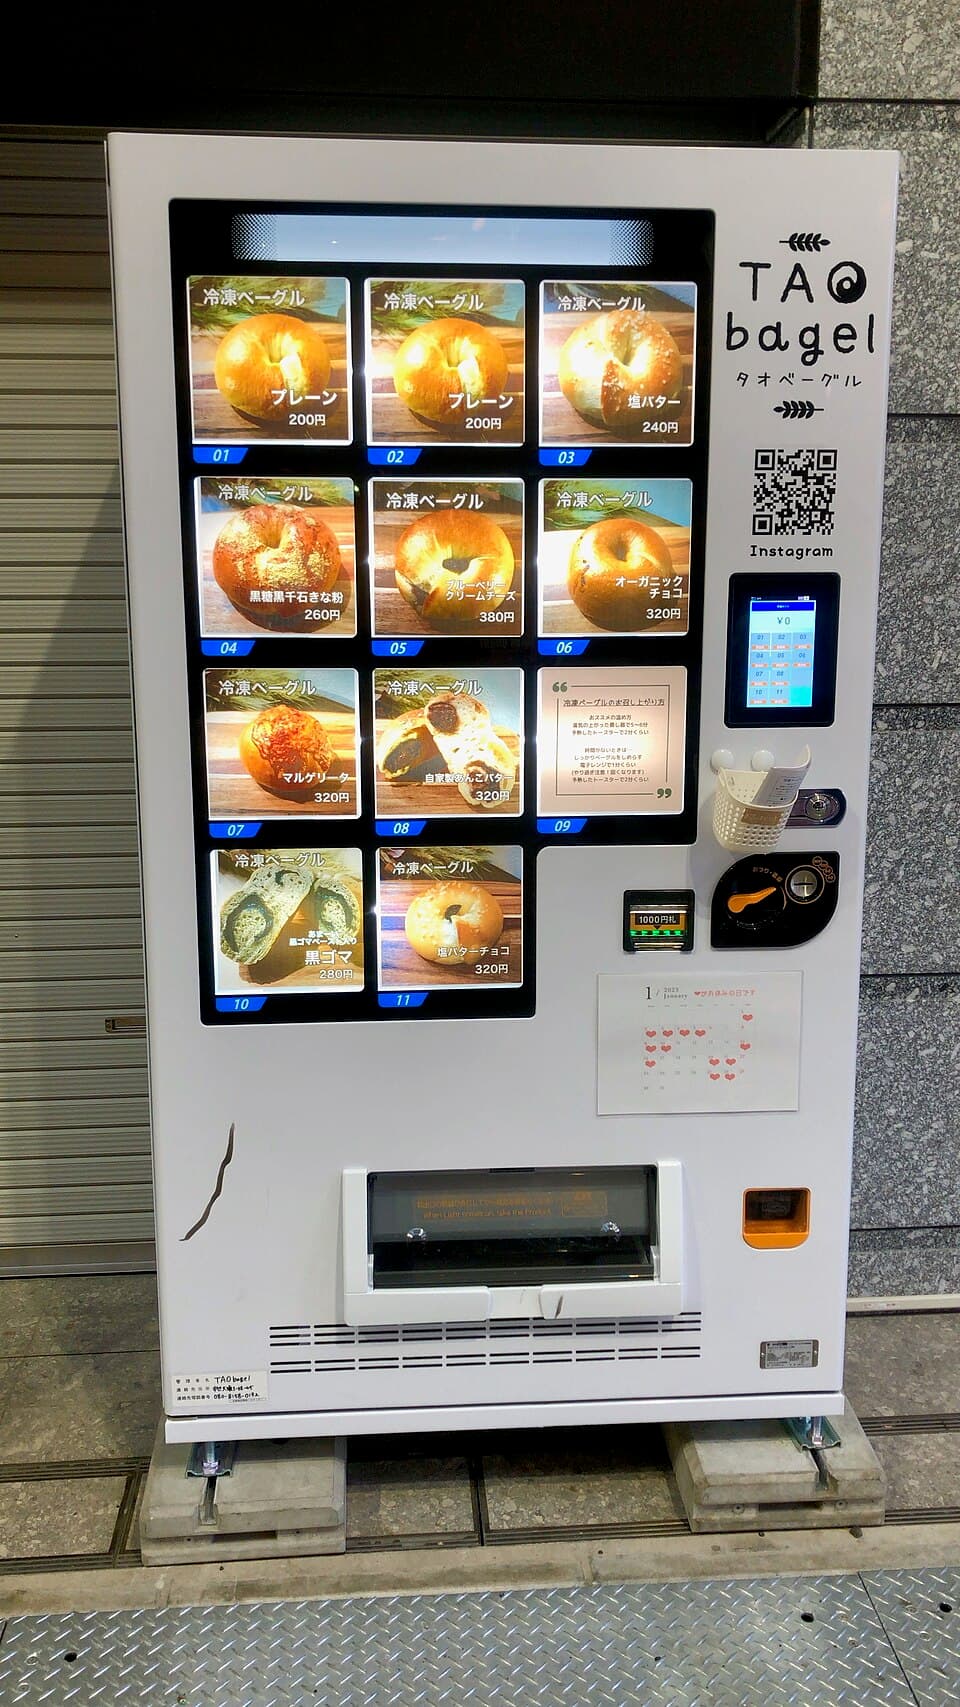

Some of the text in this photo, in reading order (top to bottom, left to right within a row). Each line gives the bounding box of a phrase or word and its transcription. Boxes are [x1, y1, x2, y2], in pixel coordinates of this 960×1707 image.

[739, 261, 866, 304] TAO
[203, 287, 305, 308] 冷凍ベーグル
[383, 292, 484, 312] 冷凍ベーグル
[557, 295, 646, 313] 冷凍ベーグル
[726, 311, 874, 366] bagel
[736, 371, 862, 387] タオベーグル
[271, 389, 338, 409] プレーン
[449, 393, 513, 411] プレーン
[628, 394, 681, 410] 塩バター
[288, 413, 326, 427] 200円
[465, 416, 502, 430] 200円
[642, 420, 678, 434] 240円
[213, 449, 229, 463] 01
[387, 450, 404, 464] 02
[558, 451, 574, 464] 03
[218, 485, 312, 502] 冷凍ベーグル
[557, 490, 653, 508] 冷凍ベーグル
[386, 492, 484, 510] 冷凍ベーグル
[750, 544, 834, 560] Instagram
[447, 580, 505, 590] ブルーベリー
[615, 576, 683, 588] オーガニック
[249, 590, 343, 604] 黒糖黒千石きな粉
[446, 590, 516, 601] クリームチーズ
[649, 588, 683, 600] チョコ
[304, 609, 341, 621] 260円
[479, 611, 515, 623] 380円
[646, 608, 681, 620] 320円
[220, 641, 237, 654] 04
[390, 641, 407, 655] 05
[556, 641, 573, 654] 06
[218, 679, 316, 697] 冷凍ベーグル
[386, 678, 483, 697] 冷凍ベーグル
[282, 772, 350, 784] マルゲリータ
[425, 773, 514, 783] 自家製あんこバター
[314, 791, 350, 803] 320円
[475, 790, 510, 801] 320円
[227, 823, 244, 837] 07
[393, 821, 410, 835] 08
[554, 819, 571, 832] 09
[235, 852, 326, 869] 冷凍ベーグル
[392, 861, 474, 875] 冷凍ベーグル
[304, 949, 353, 965] 黒ゴマ
[437, 945, 510, 957] 塩バターチョコ
[319, 969, 353, 979] 280円
[475, 963, 509, 975] 320円
[234, 998, 250, 1010] 10
[396, 994, 411, 1006] 11
